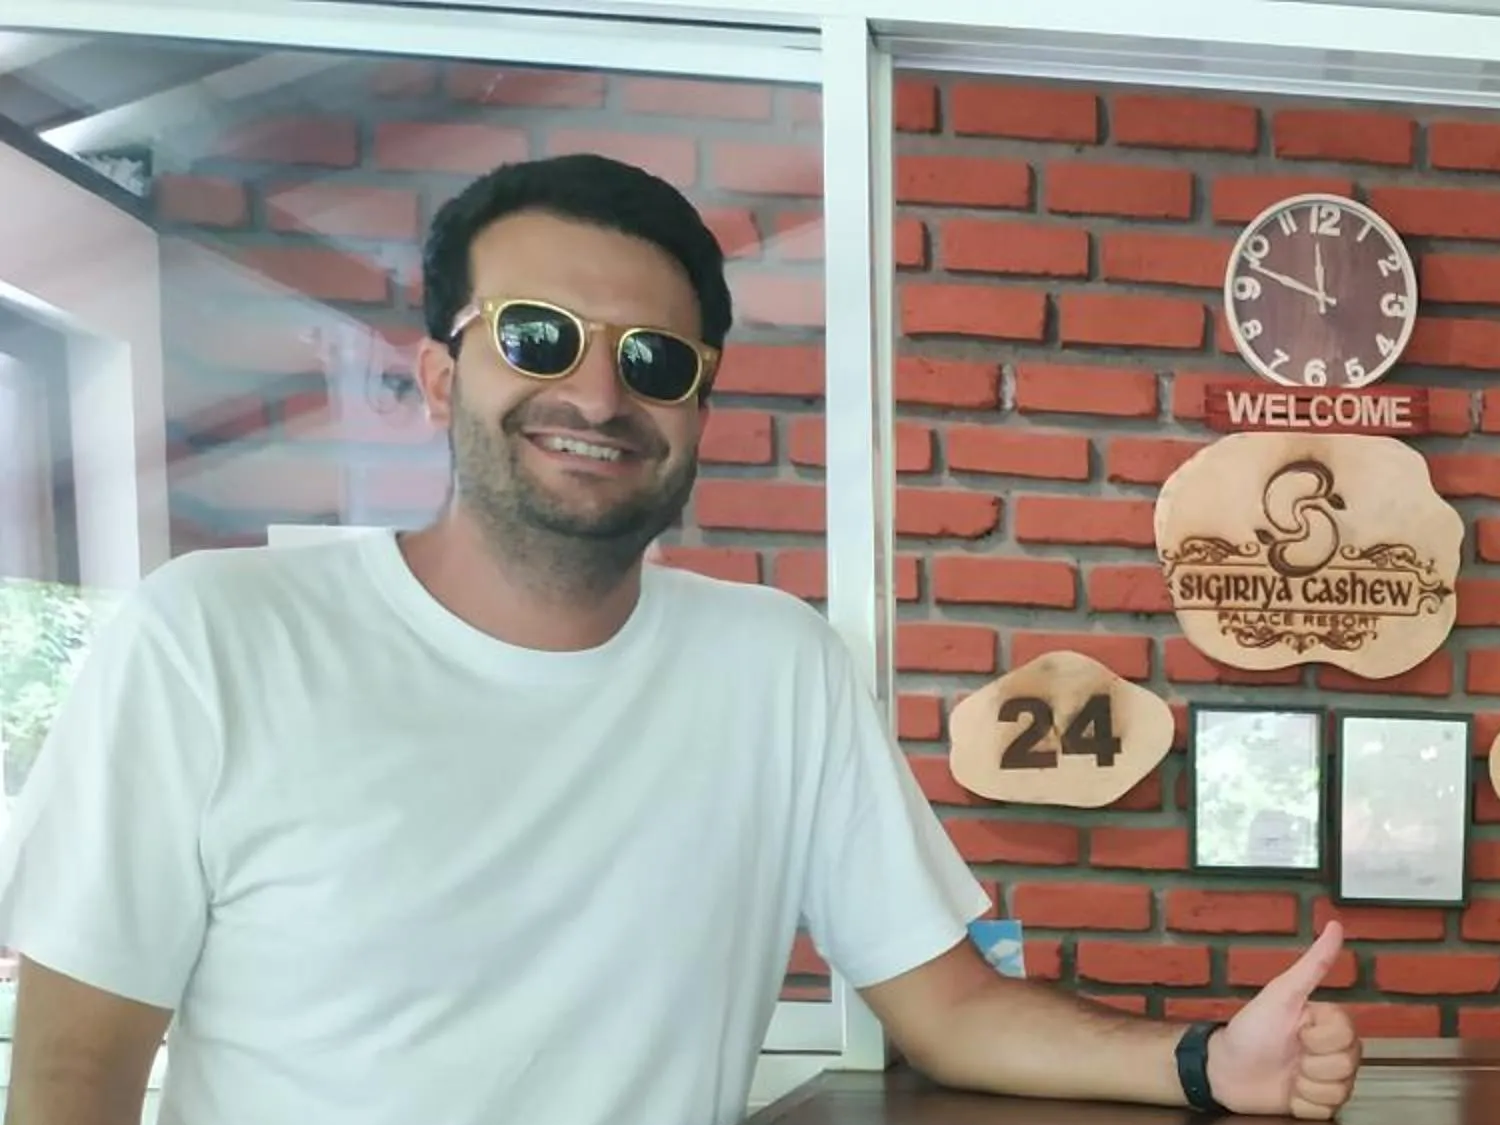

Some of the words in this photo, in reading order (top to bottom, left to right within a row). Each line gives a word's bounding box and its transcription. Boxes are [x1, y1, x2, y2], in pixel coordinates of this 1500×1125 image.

[1278, 209, 1298, 236] 11
[1309, 204, 1341, 236] 12
[1377, 254, 1402, 278] 2
[1234, 276, 1261, 300] 9
[1380, 293, 1407, 317] 3
[1241, 319, 1263, 340] 8
[1376, 333, 1396, 357] 4
[1268, 349, 1290, 370] 7
[1344, 357, 1365, 382] 5
[1304, 358, 1327, 386] 6
[1226, 391, 1412, 428] WELCOME
[1217, 611, 1294, 627] PALACE
[1303, 613, 1380, 630] RESORT
[998, 694, 1122, 769] 24
